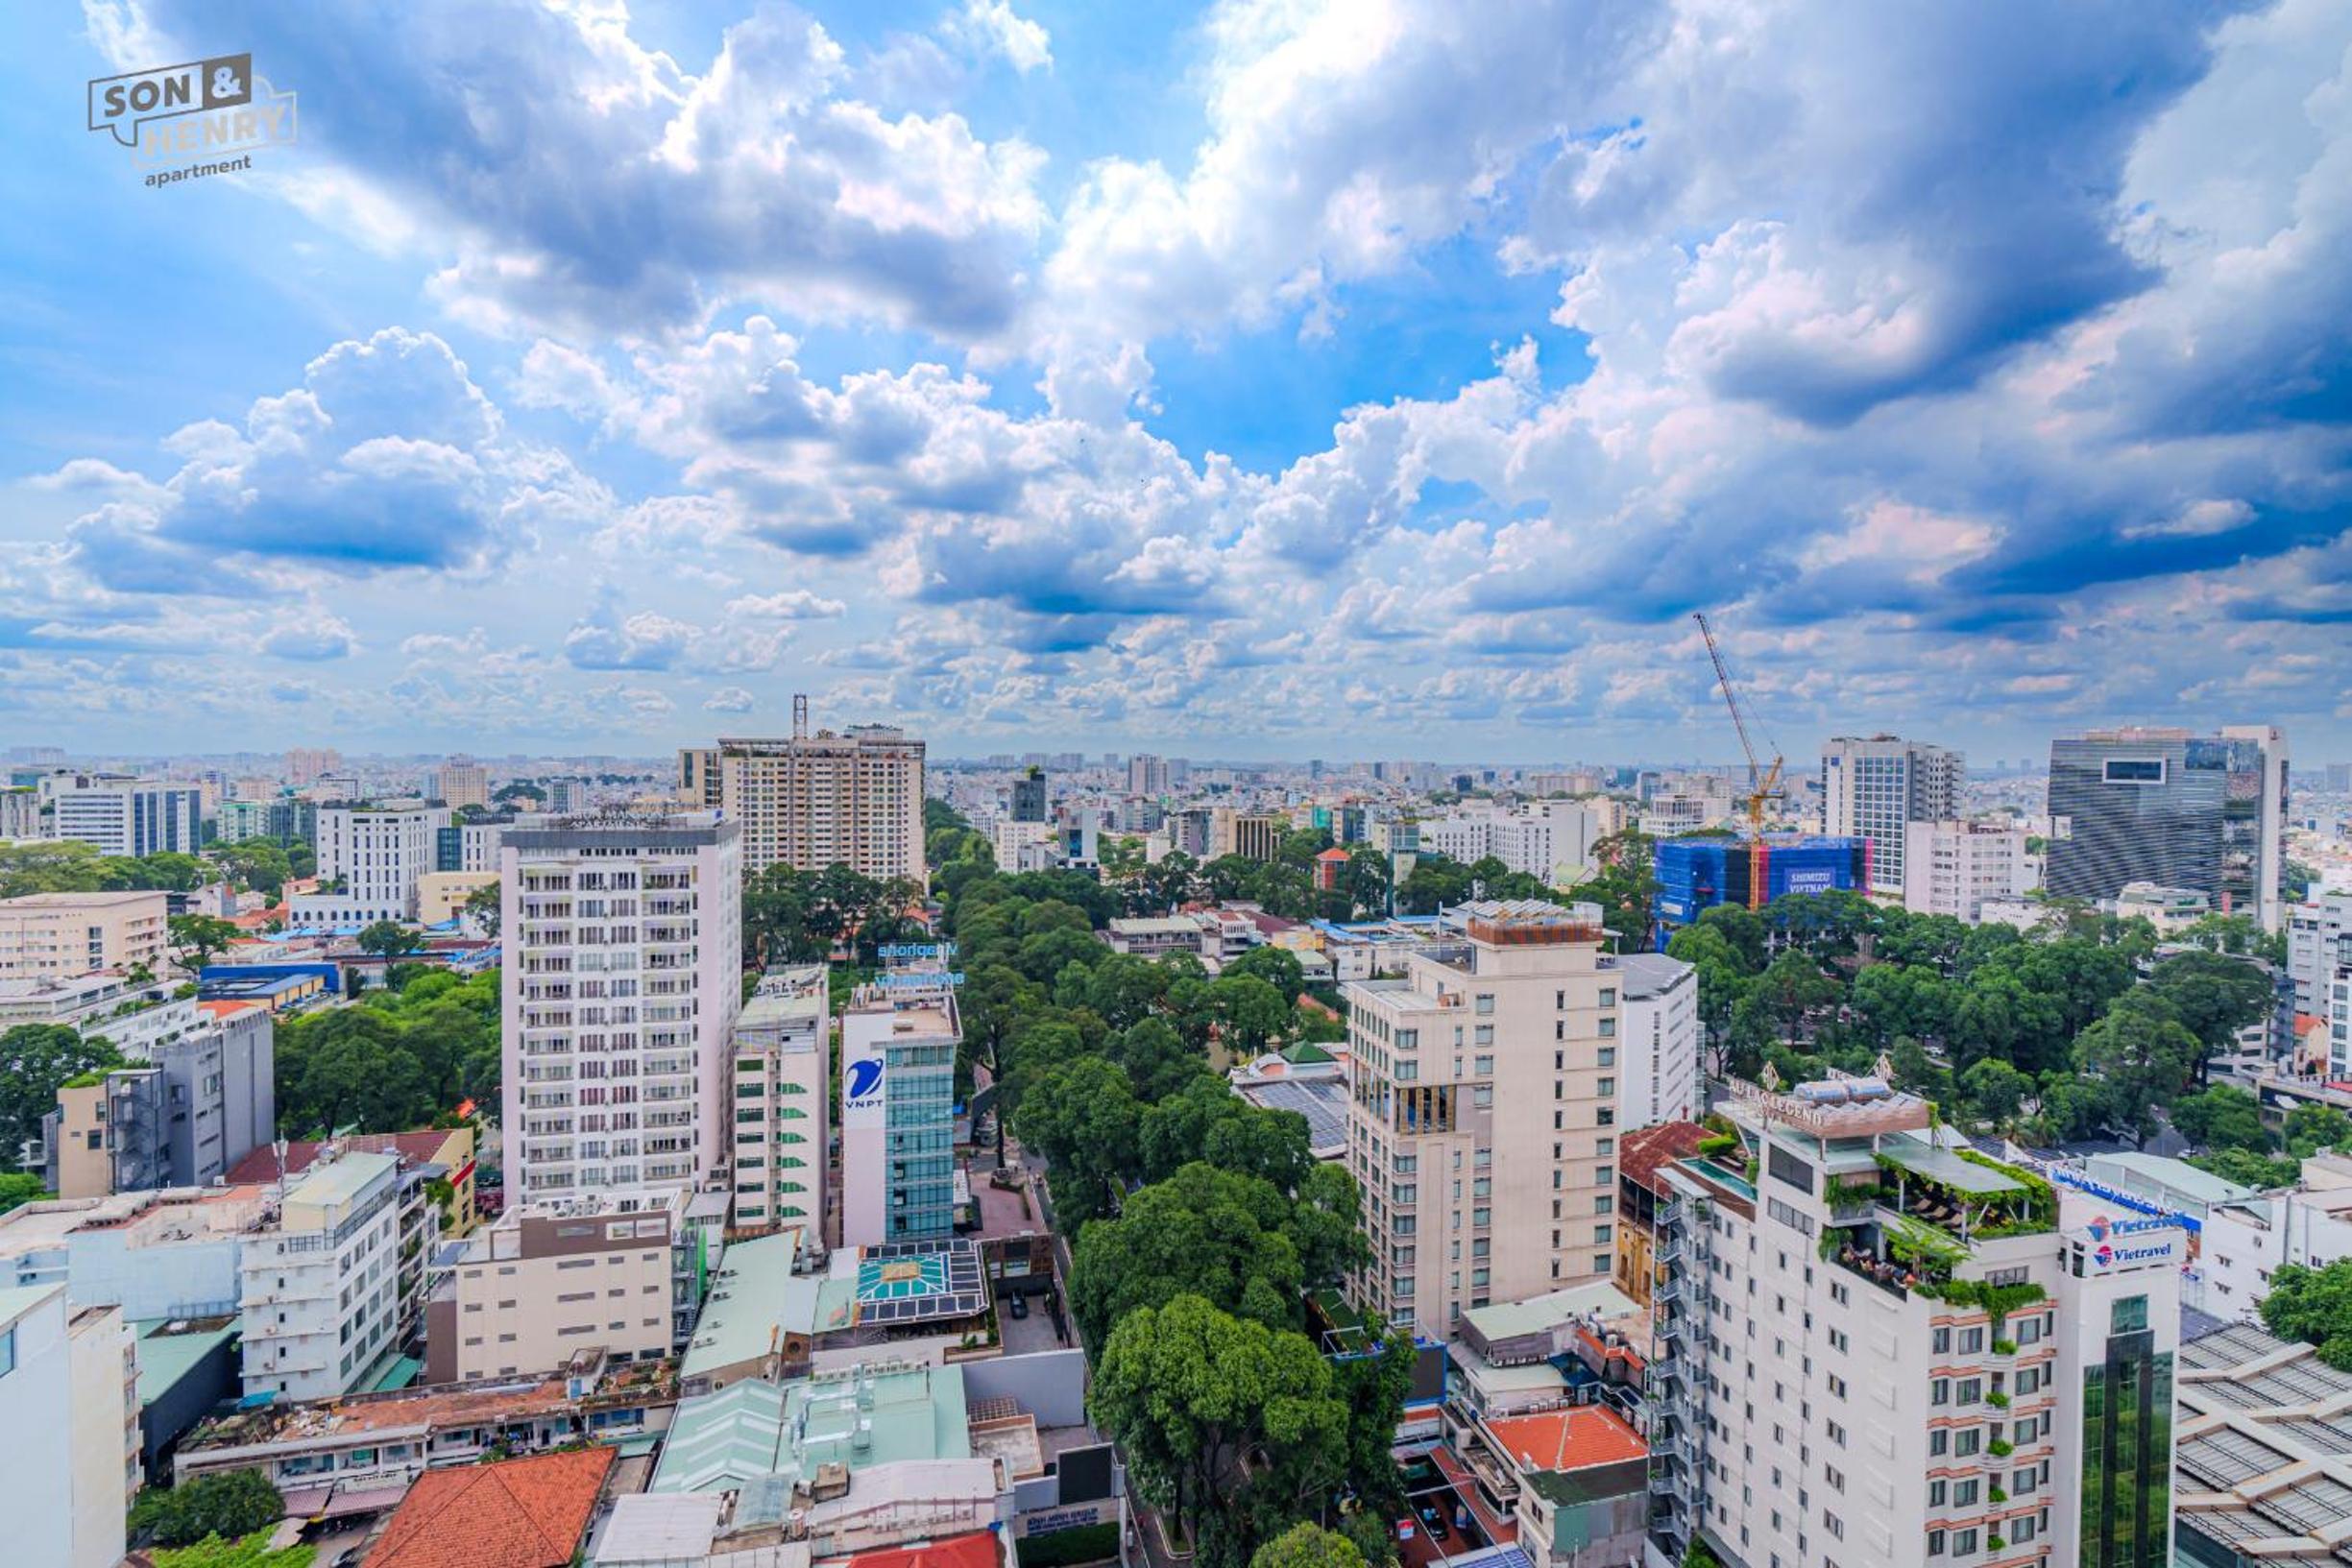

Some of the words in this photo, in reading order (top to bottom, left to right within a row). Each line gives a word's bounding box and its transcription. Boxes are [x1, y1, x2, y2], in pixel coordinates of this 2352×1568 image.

[1790, 872, 1831, 882] SHIMIZU
[845, 1099, 883, 1108] VNPT
[1769, 1096, 1823, 1126] LEGEND
[2115, 1243, 2170, 1260] Vietravel
